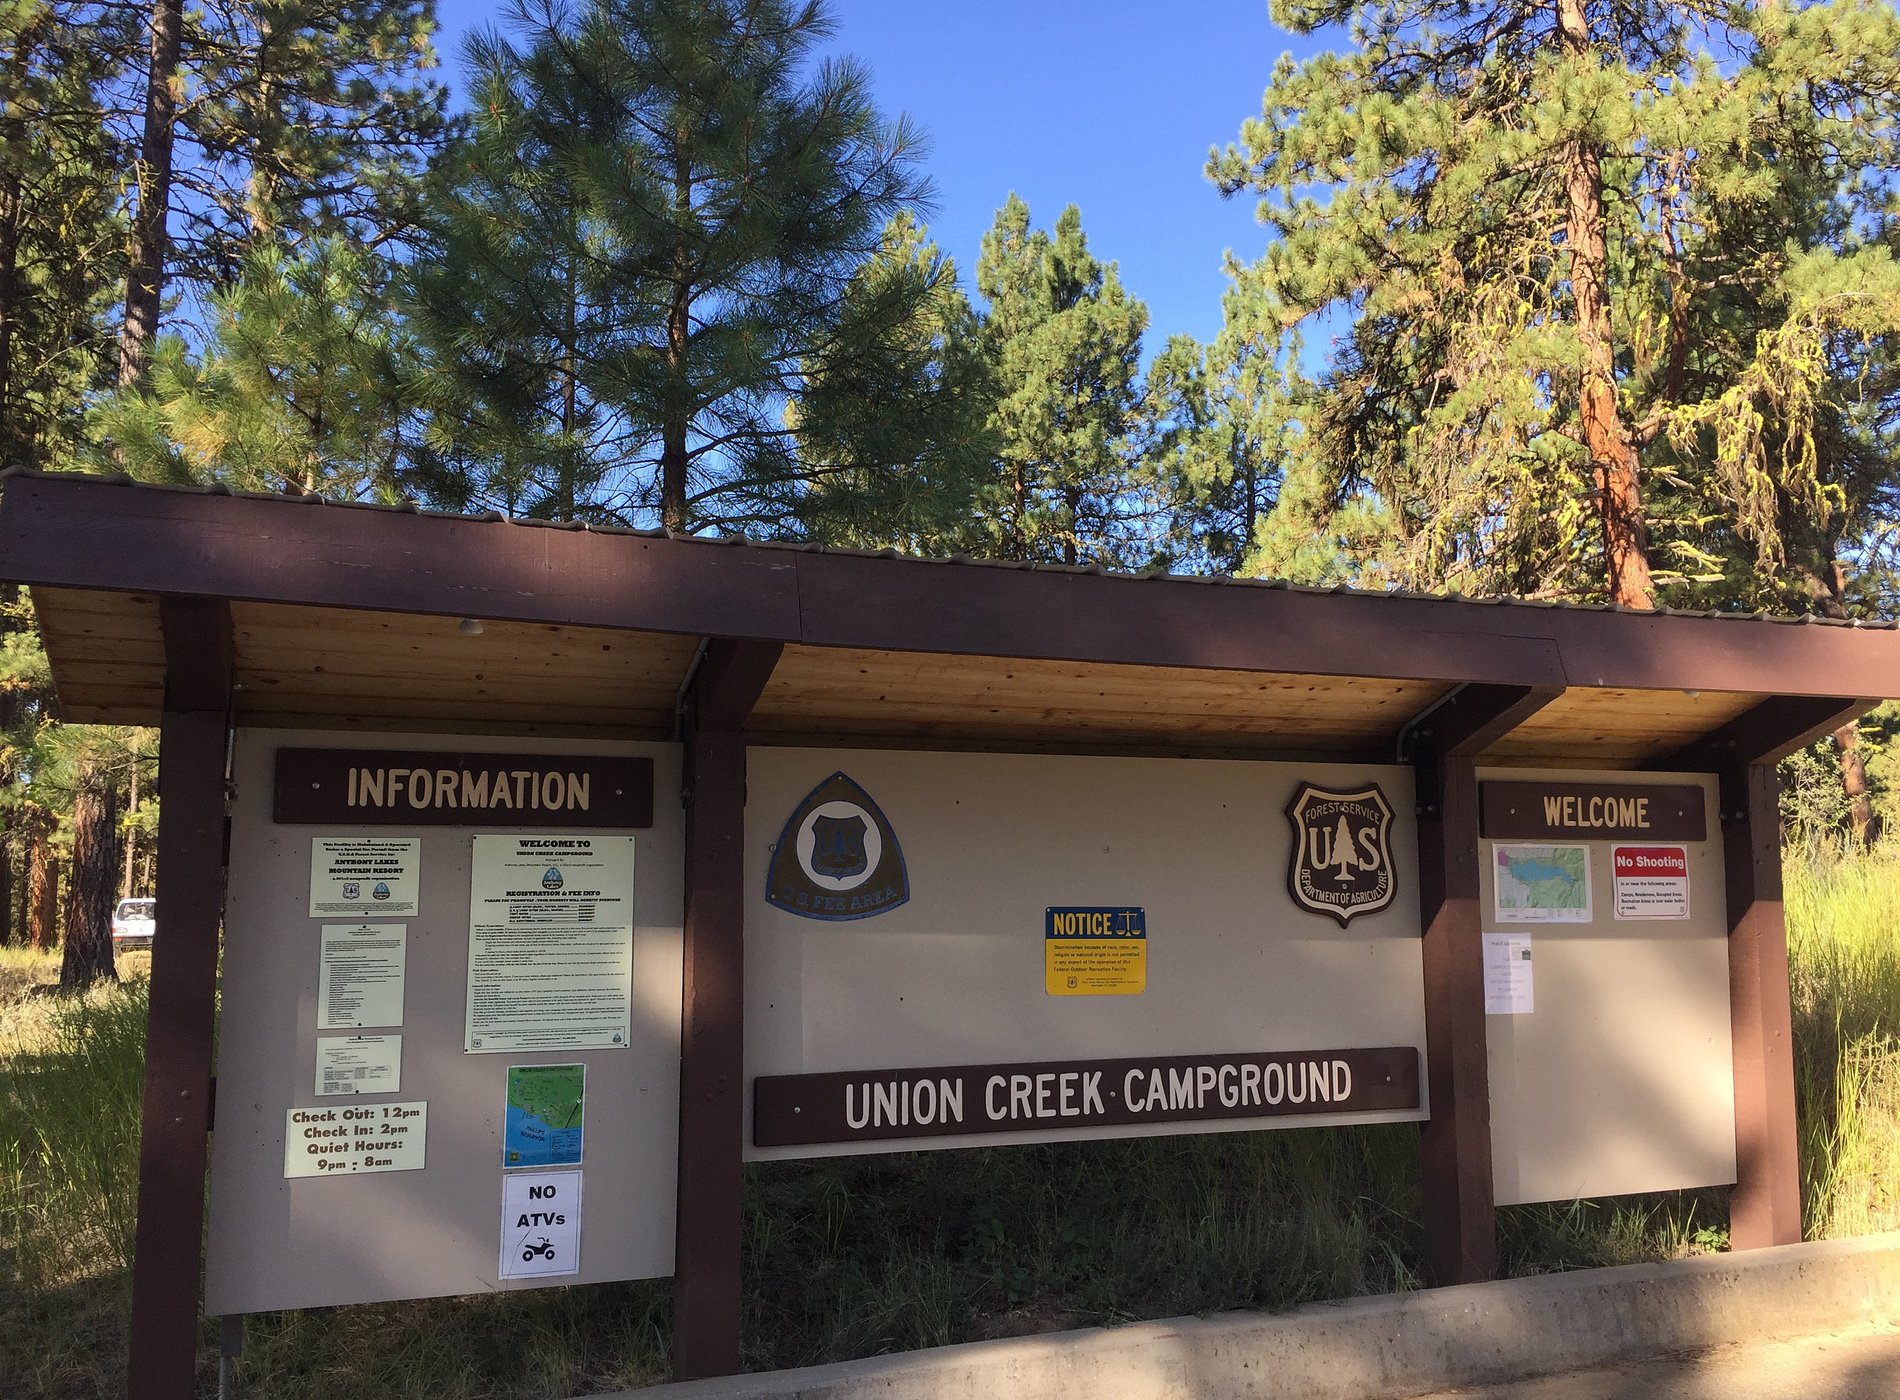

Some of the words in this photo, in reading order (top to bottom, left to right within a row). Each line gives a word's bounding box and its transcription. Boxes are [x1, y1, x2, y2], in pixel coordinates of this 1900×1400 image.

[347, 768, 590, 811] INFORMATION
[1305, 802, 1340, 823] FOREST
[1343, 802, 1380, 824] SERVICE
[1544, 796, 1650, 828] WELCOME
[519, 840, 575, 848] WELCOME
[576, 840, 591, 848] TO
[1617, 856, 1633, 867] No
[1636, 856, 1684, 869] Shooting
[1301, 869, 1340, 903] DEPARTMENT
[1340, 893, 1350, 904] OF
[1351, 870, 1387, 903] AGRICULTURE
[813, 896, 845, 910] FEE
[852, 885, 896, 909] AREA
[1054, 913, 1112, 935] NOTICE
[844, 1077, 964, 1129] UNION
[985, 1070, 1105, 1120] CREEK
[1123, 1060, 1352, 1113] CAMPGROUND
[292, 1110, 336, 1123] Check
[343, 1110, 374, 1120] Out:
[382, 1107, 420, 1119] 12pm
[304, 1126, 347, 1138] Check
[354, 1125, 373, 1135] In:
[380, 1124, 408, 1135] 2pm
[307, 1143, 349, 1154] Quiet
[355, 1141, 402, 1152] Hours:
[318, 1159, 345, 1171] 9pm
[364, 1156, 392, 1166] 8am
[529, 1185, 556, 1199] NO
[517, 1212, 565, 1227] ATVs
